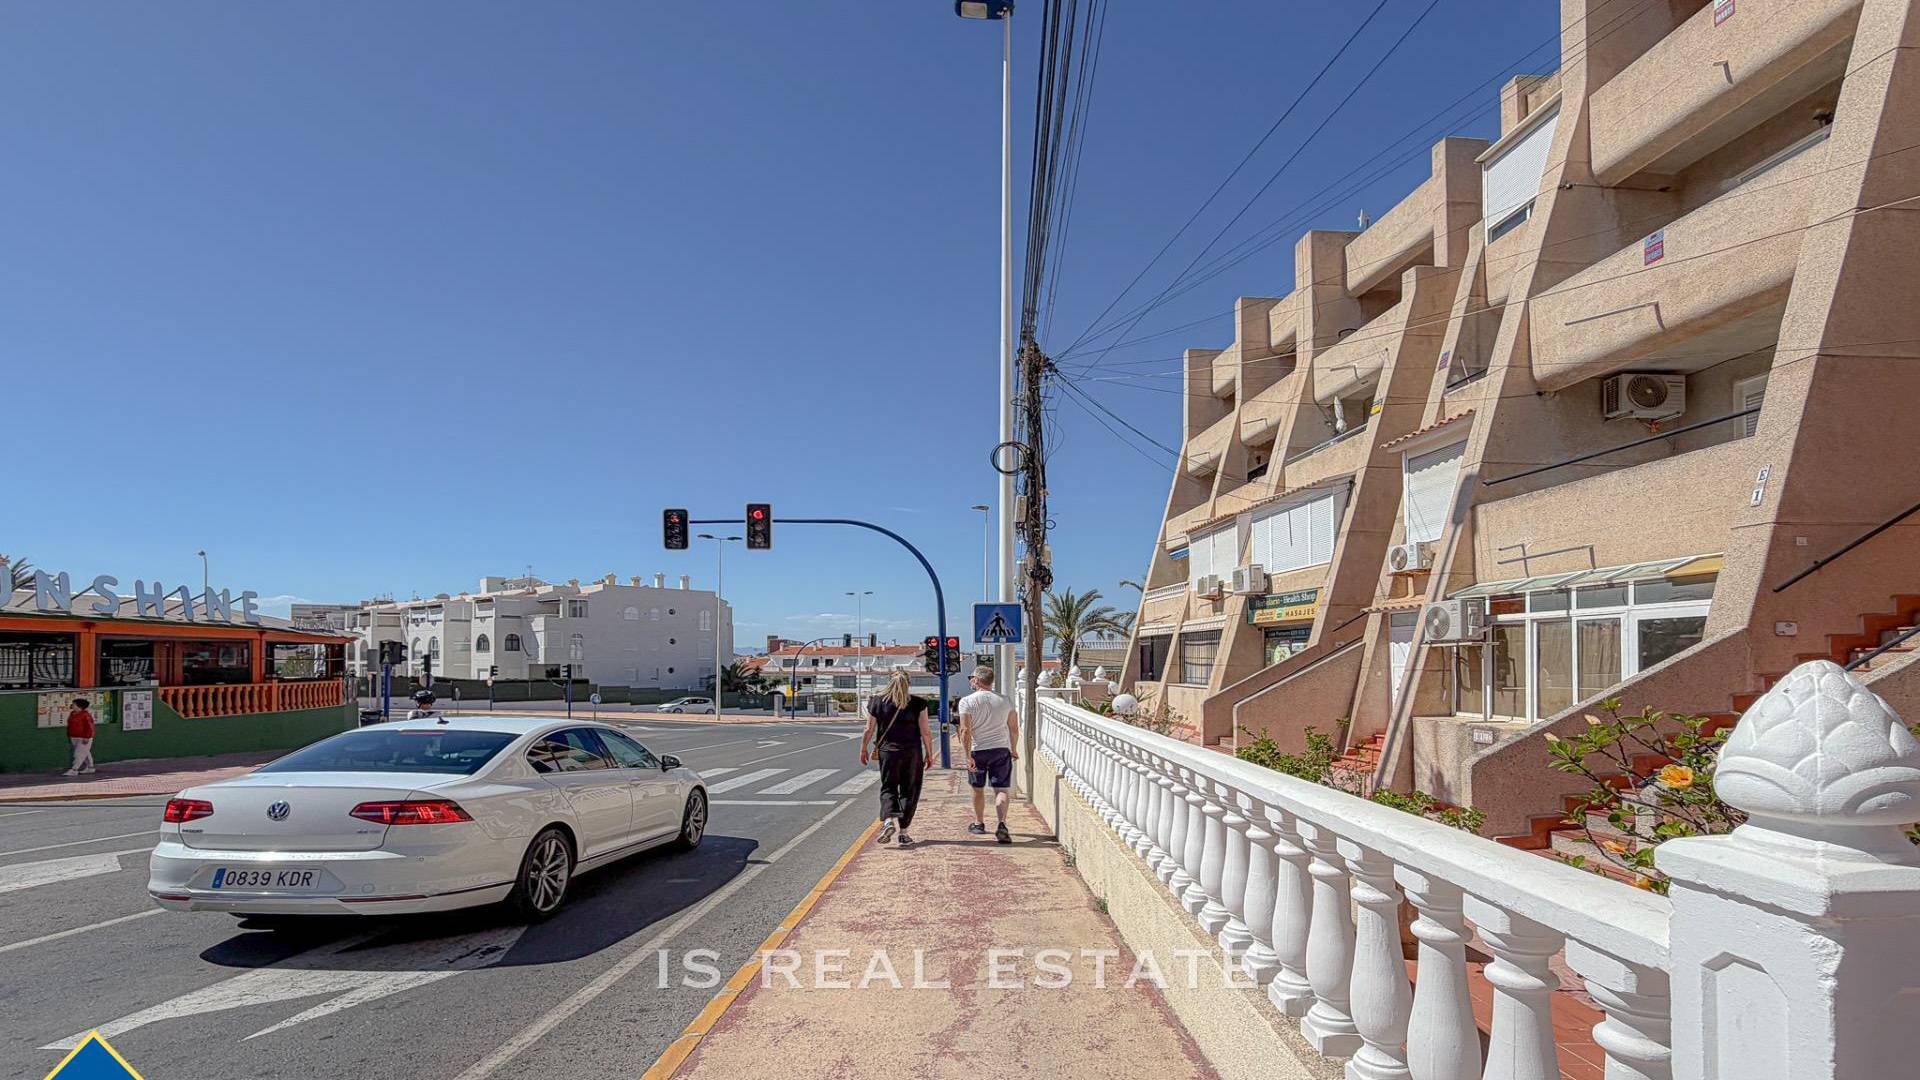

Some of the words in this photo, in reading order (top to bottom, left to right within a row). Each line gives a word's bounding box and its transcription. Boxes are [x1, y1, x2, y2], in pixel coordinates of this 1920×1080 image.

[1753, 490, 1761, 502] 1
[1301, 592, 1316, 602] Shop
[1285, 607, 1315, 617] MASAJES
[225, 871, 272, 886] 0839
[276, 871, 313, 887] KDR
